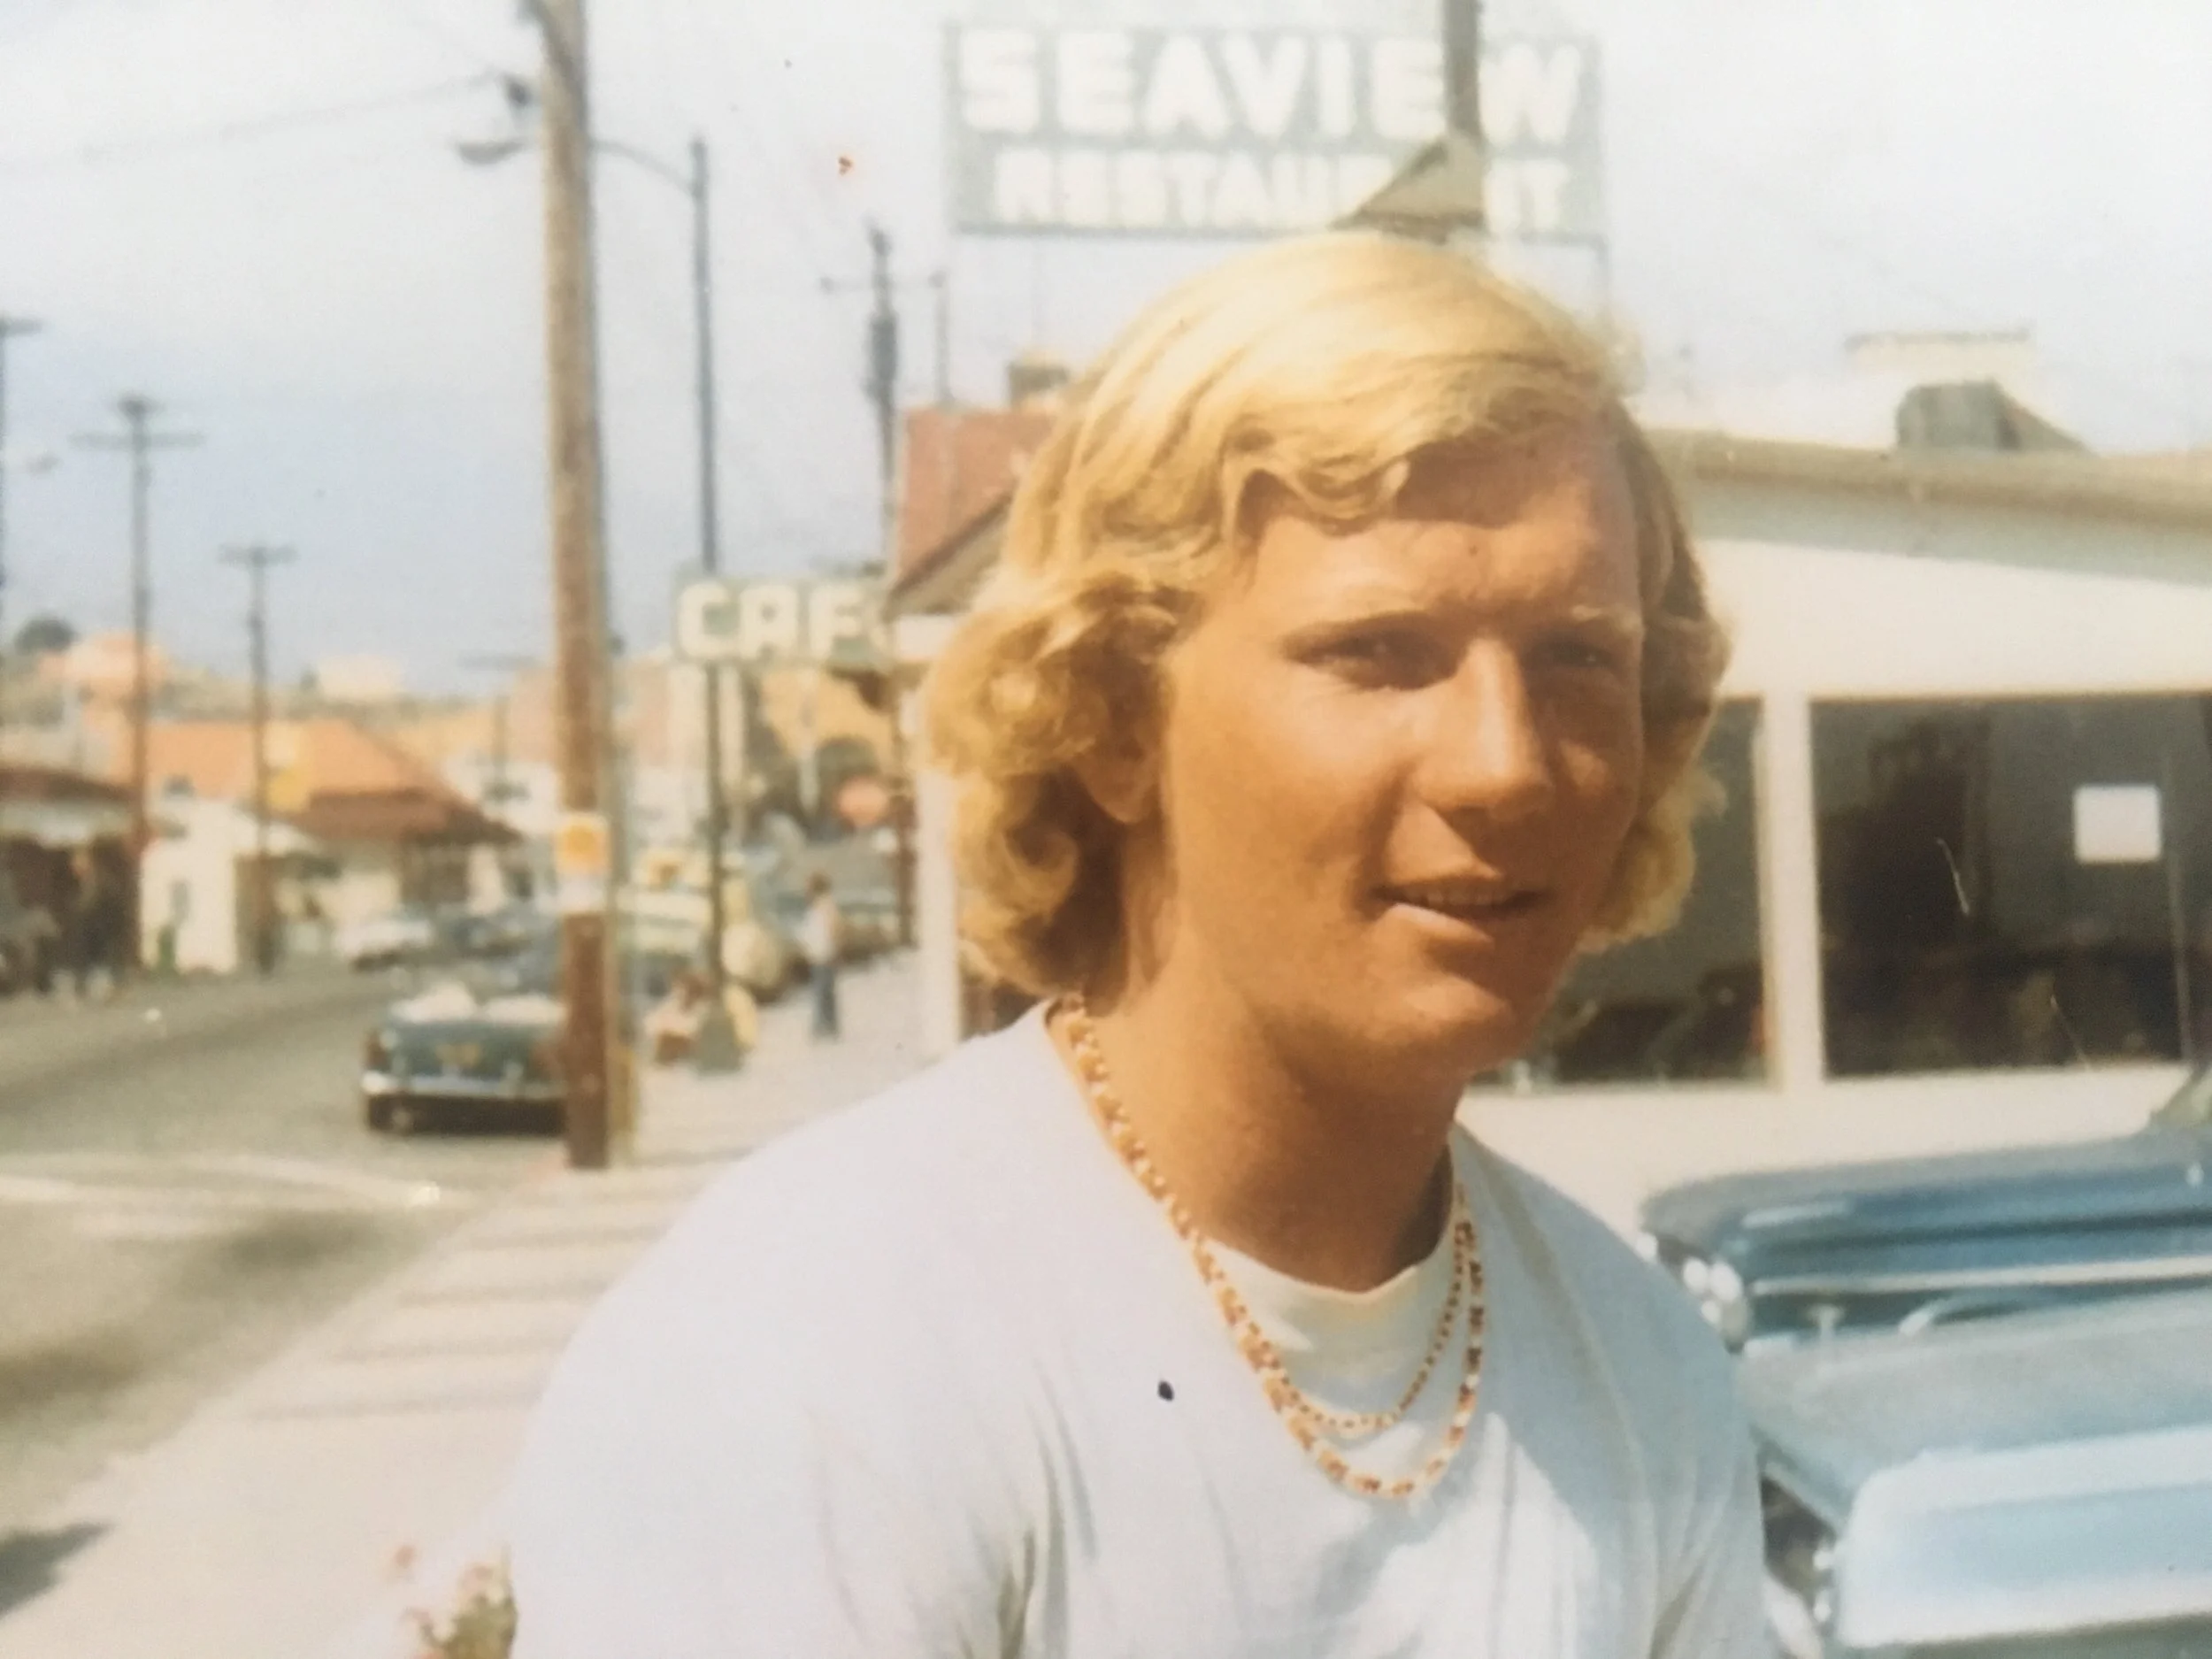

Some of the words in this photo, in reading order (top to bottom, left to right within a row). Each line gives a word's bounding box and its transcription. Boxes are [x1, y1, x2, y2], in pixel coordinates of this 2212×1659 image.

[960, 29, 1581, 143] SEAVIEW
[993, 148, 1568, 231] RESTAURT
[678, 582, 887, 659] CAF
